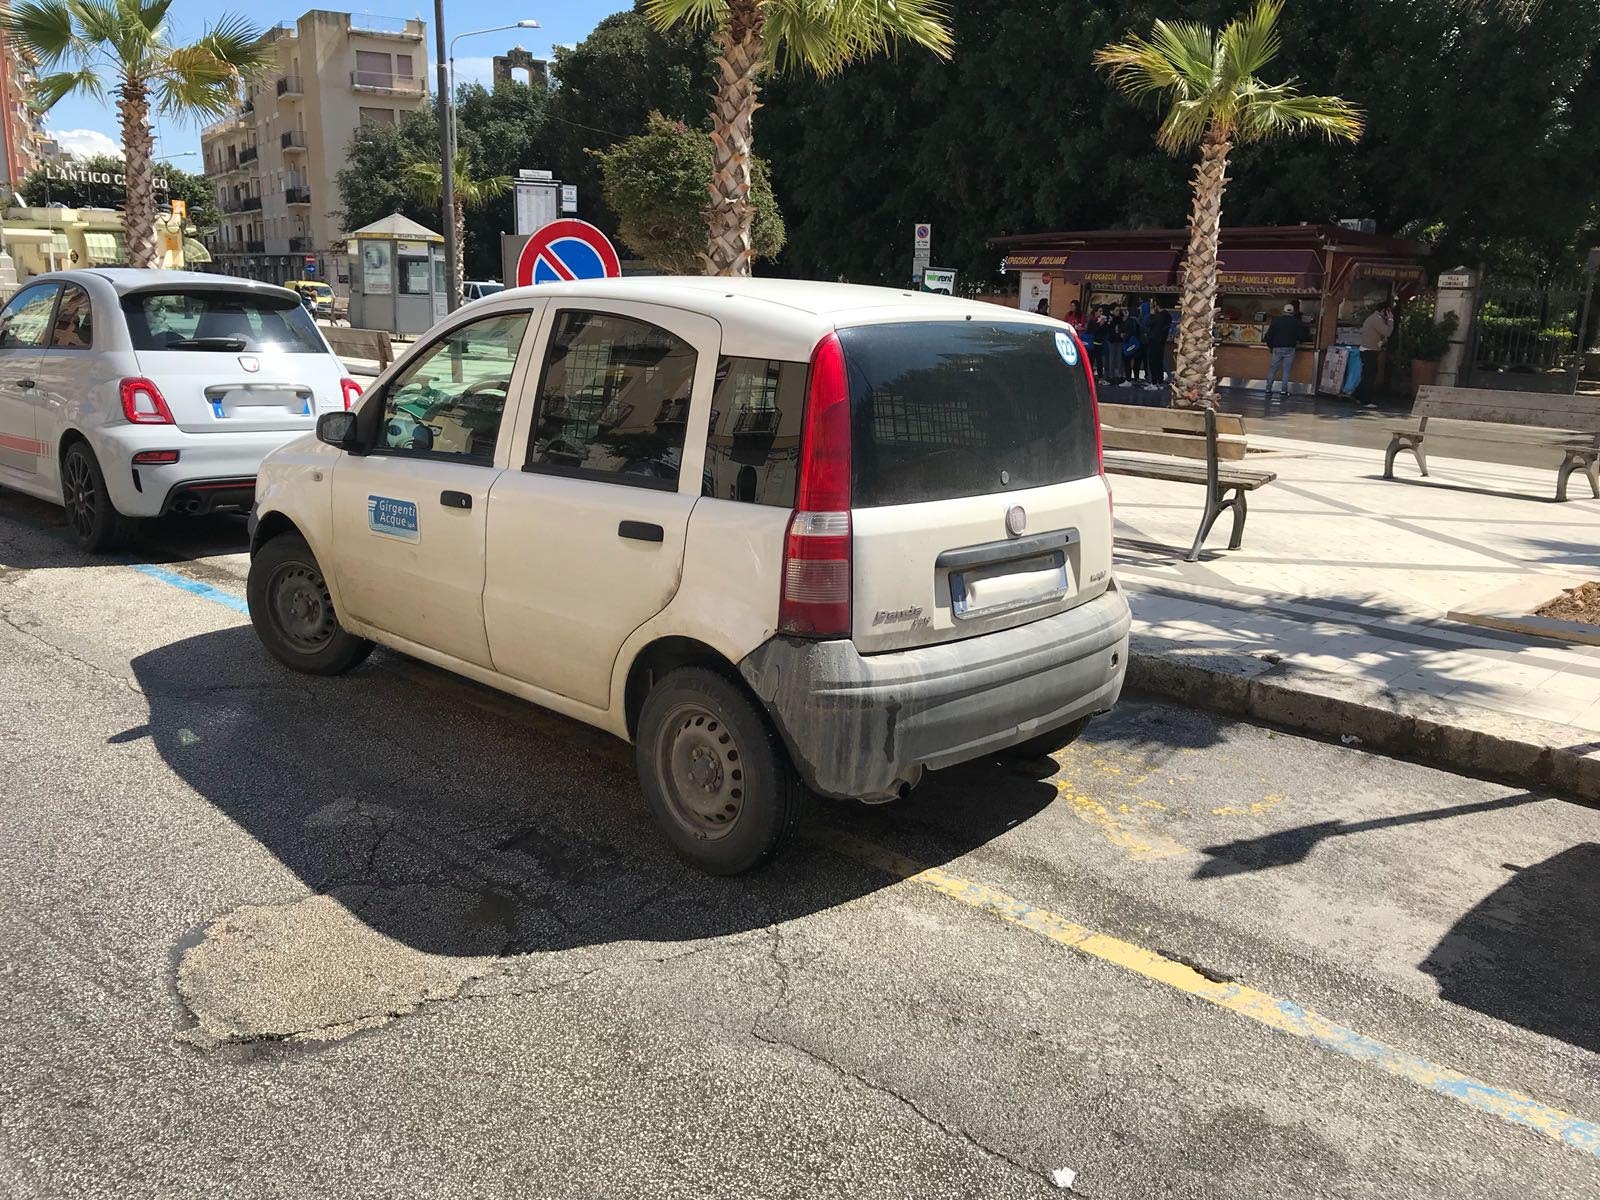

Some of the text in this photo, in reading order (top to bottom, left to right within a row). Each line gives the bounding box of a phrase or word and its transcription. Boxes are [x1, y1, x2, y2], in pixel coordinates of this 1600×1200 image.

[46, 166, 110, 184] L'ANTICO
[1092, 273, 1117, 281] FOCACCIA
[1241, 276, 1269, 284] PANELLE
[1273, 276, 1296, 285] KEBAB
[1057, 338, 1075, 356] 122
[379, 500, 416, 516] Girgenti
[379, 512, 407, 527] Acque
[872, 605, 922, 626] Panda
